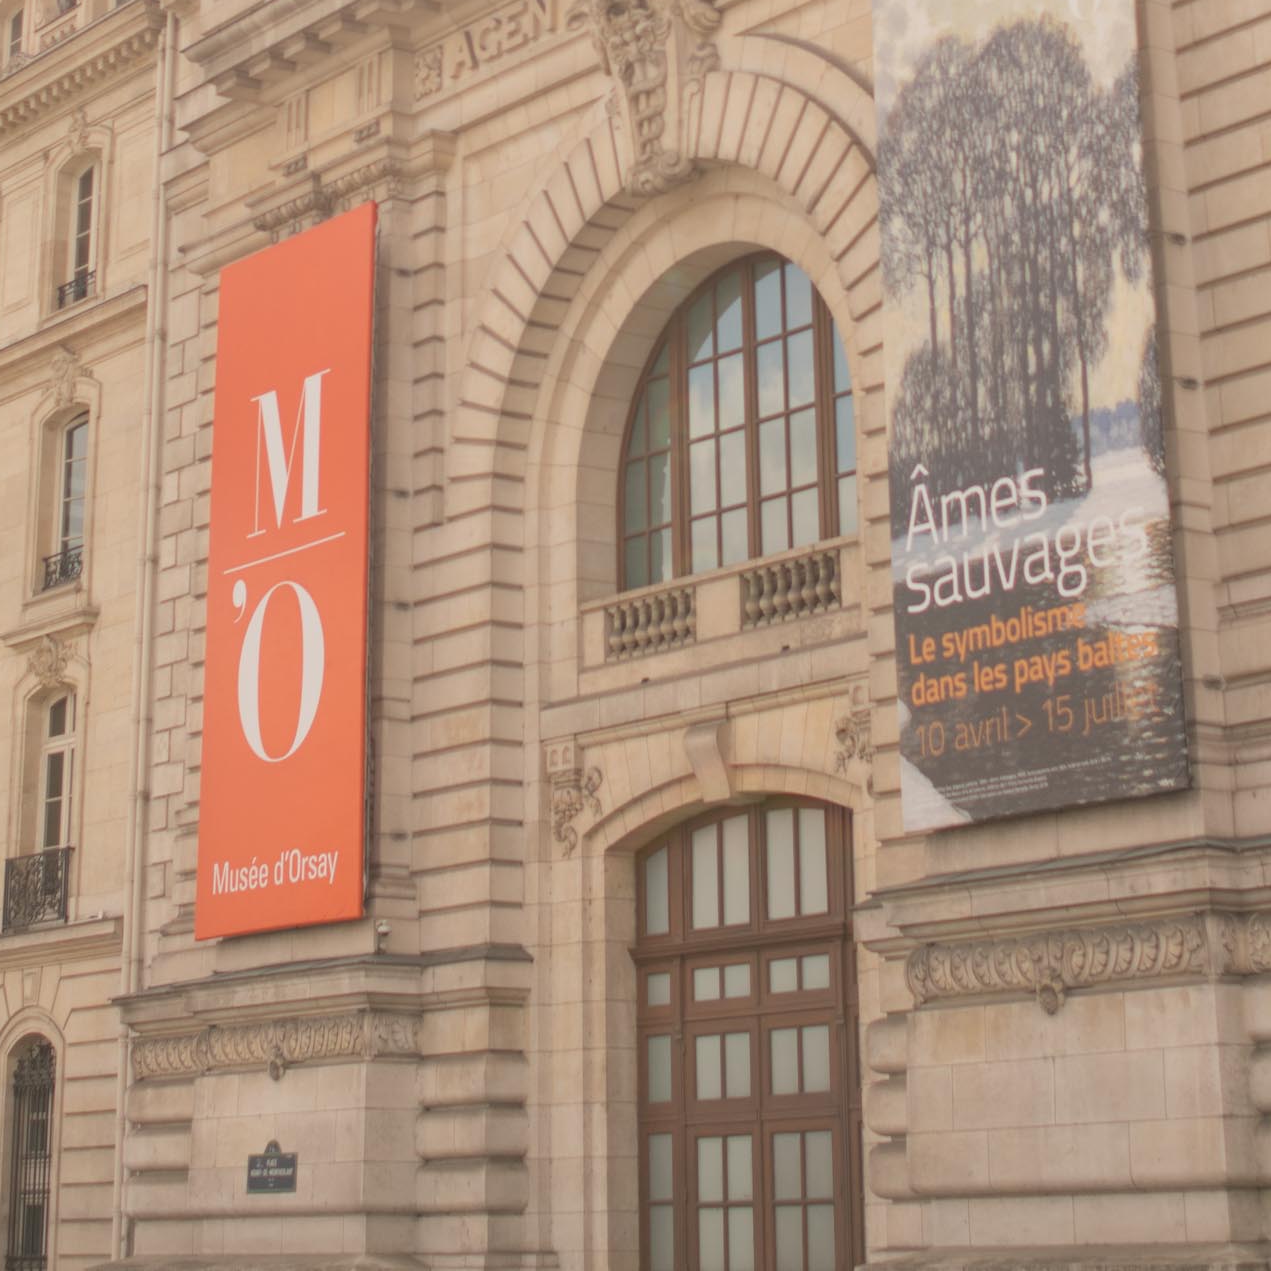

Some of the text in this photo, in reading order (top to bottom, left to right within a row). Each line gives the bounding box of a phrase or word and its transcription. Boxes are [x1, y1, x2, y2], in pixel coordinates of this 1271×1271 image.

[245, 368, 332, 540] M
[906, 463, 1048, 553] Âmes
[906, 506, 1148, 614] sauvages
[909, 601, 1087, 665] Le symbolisme
[911, 630, 1160, 707] dans les pays baltes
[915, 719, 946, 758] 10
[954, 705, 1009, 751] avril
[1041, 694, 1074, 733] 15
[212, 848, 339, 896] Musée d'Orsay
